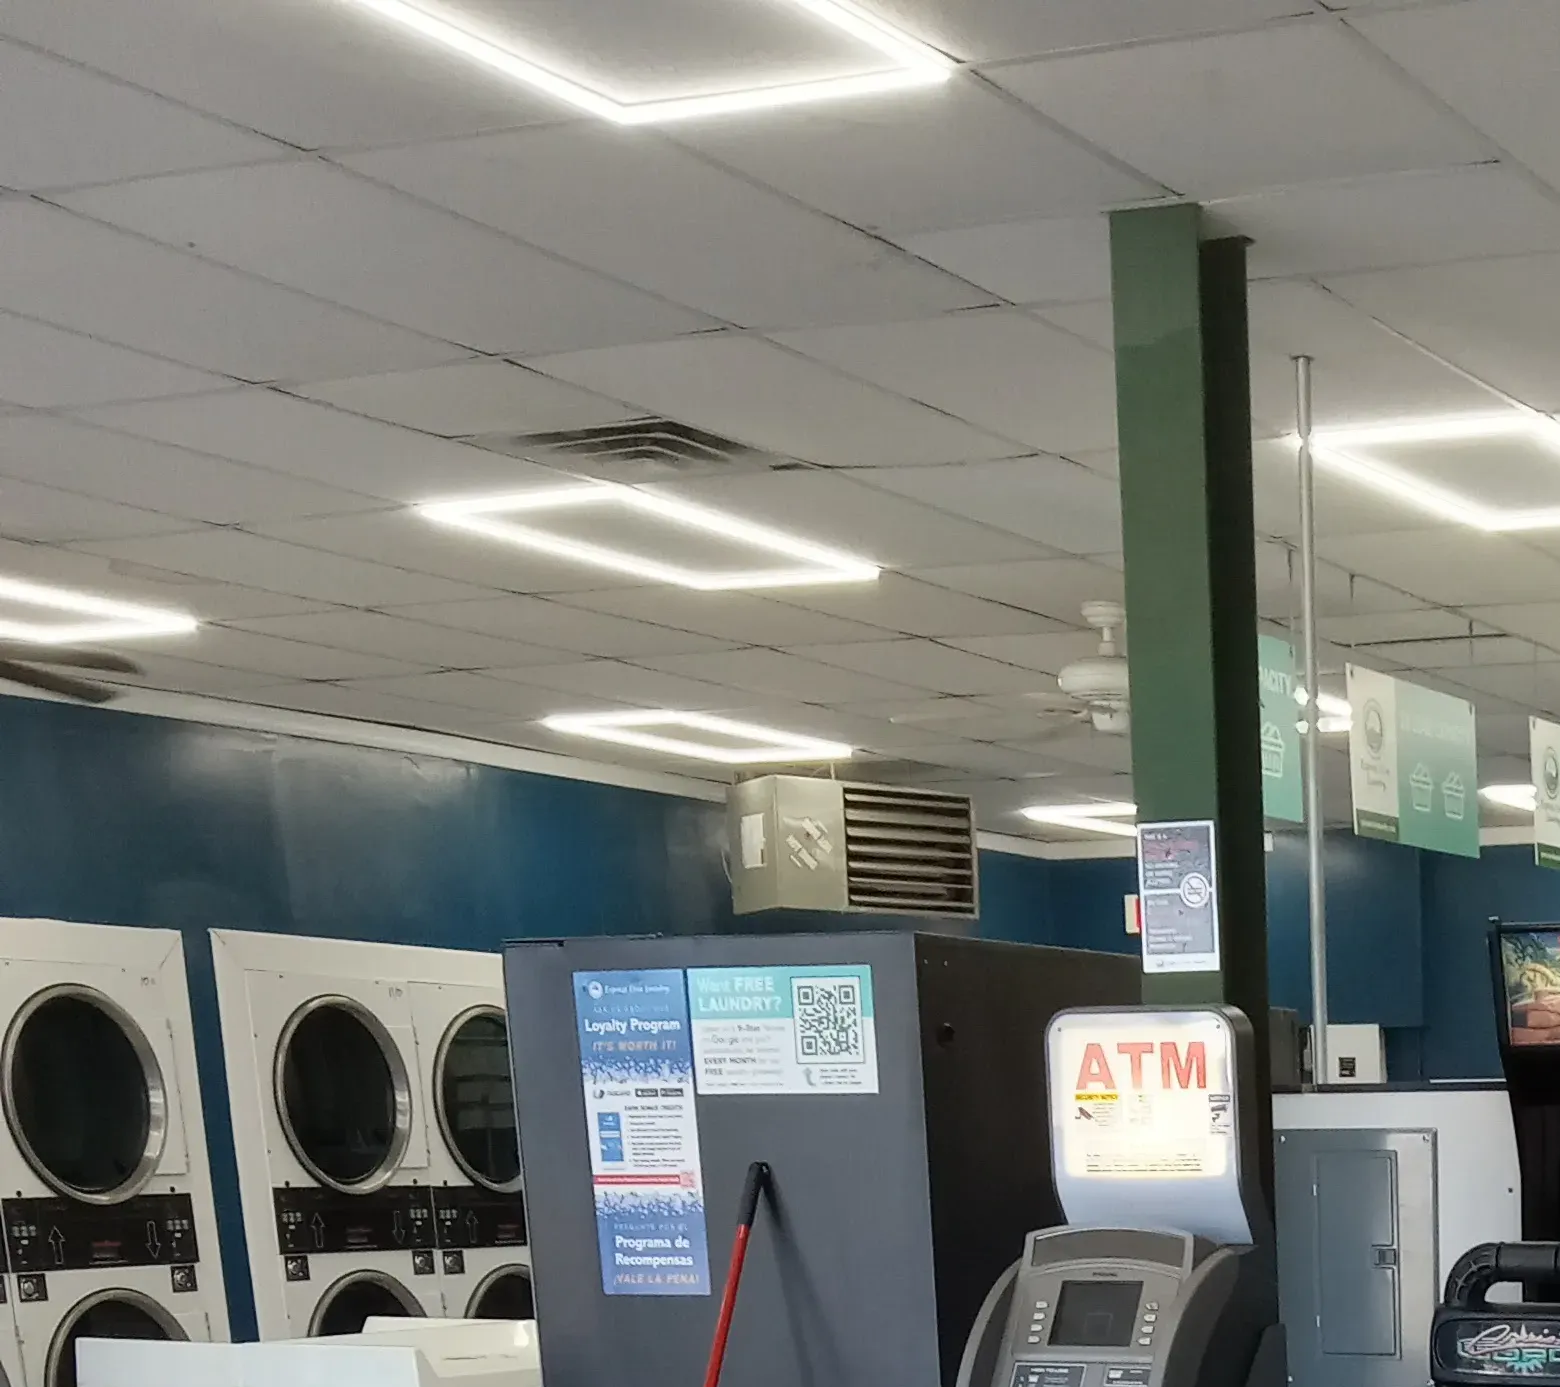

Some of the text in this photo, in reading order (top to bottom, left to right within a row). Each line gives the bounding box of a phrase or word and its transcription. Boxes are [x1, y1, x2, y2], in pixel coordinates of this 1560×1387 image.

[733, 976, 775, 993] FREE
[700, 996, 782, 1012] LAUNDRY?
[584, 1018, 681, 1036] Loyalty Program
[593, 1041, 614, 1051] IT'S
[618, 1041, 657, 1052] WORTH
[1075, 1041, 1207, 1090] ATM
[615, 1235, 690, 1251] Programa de
[615, 1253, 694, 1269] Recompensas
[647, 1274, 661, 1284] LA
